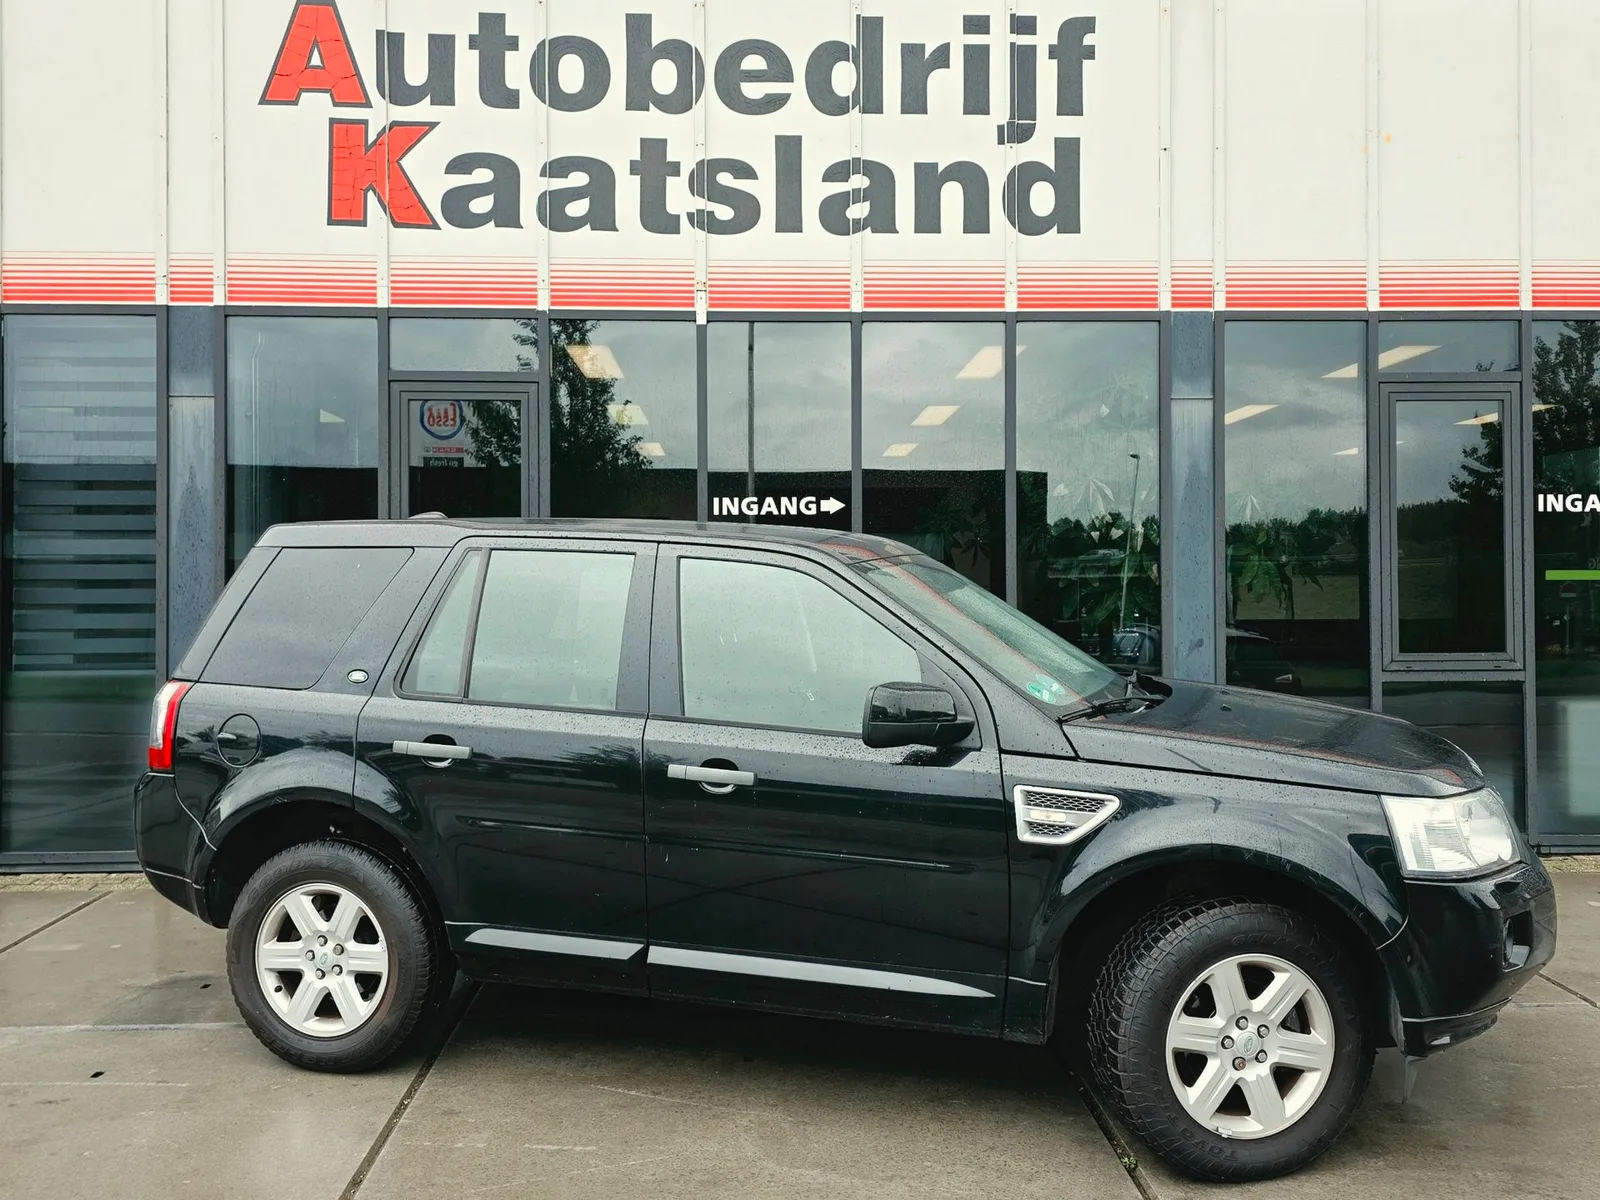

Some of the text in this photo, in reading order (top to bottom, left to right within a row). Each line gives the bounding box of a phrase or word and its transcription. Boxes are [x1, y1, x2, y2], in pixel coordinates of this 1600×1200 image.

[259, 0, 1096, 143] Autobedrijf
[327, 119, 1081, 236] Kaatsland
[712, 496, 817, 516] INGANG
[1537, 493, 1600, 513] INGA
